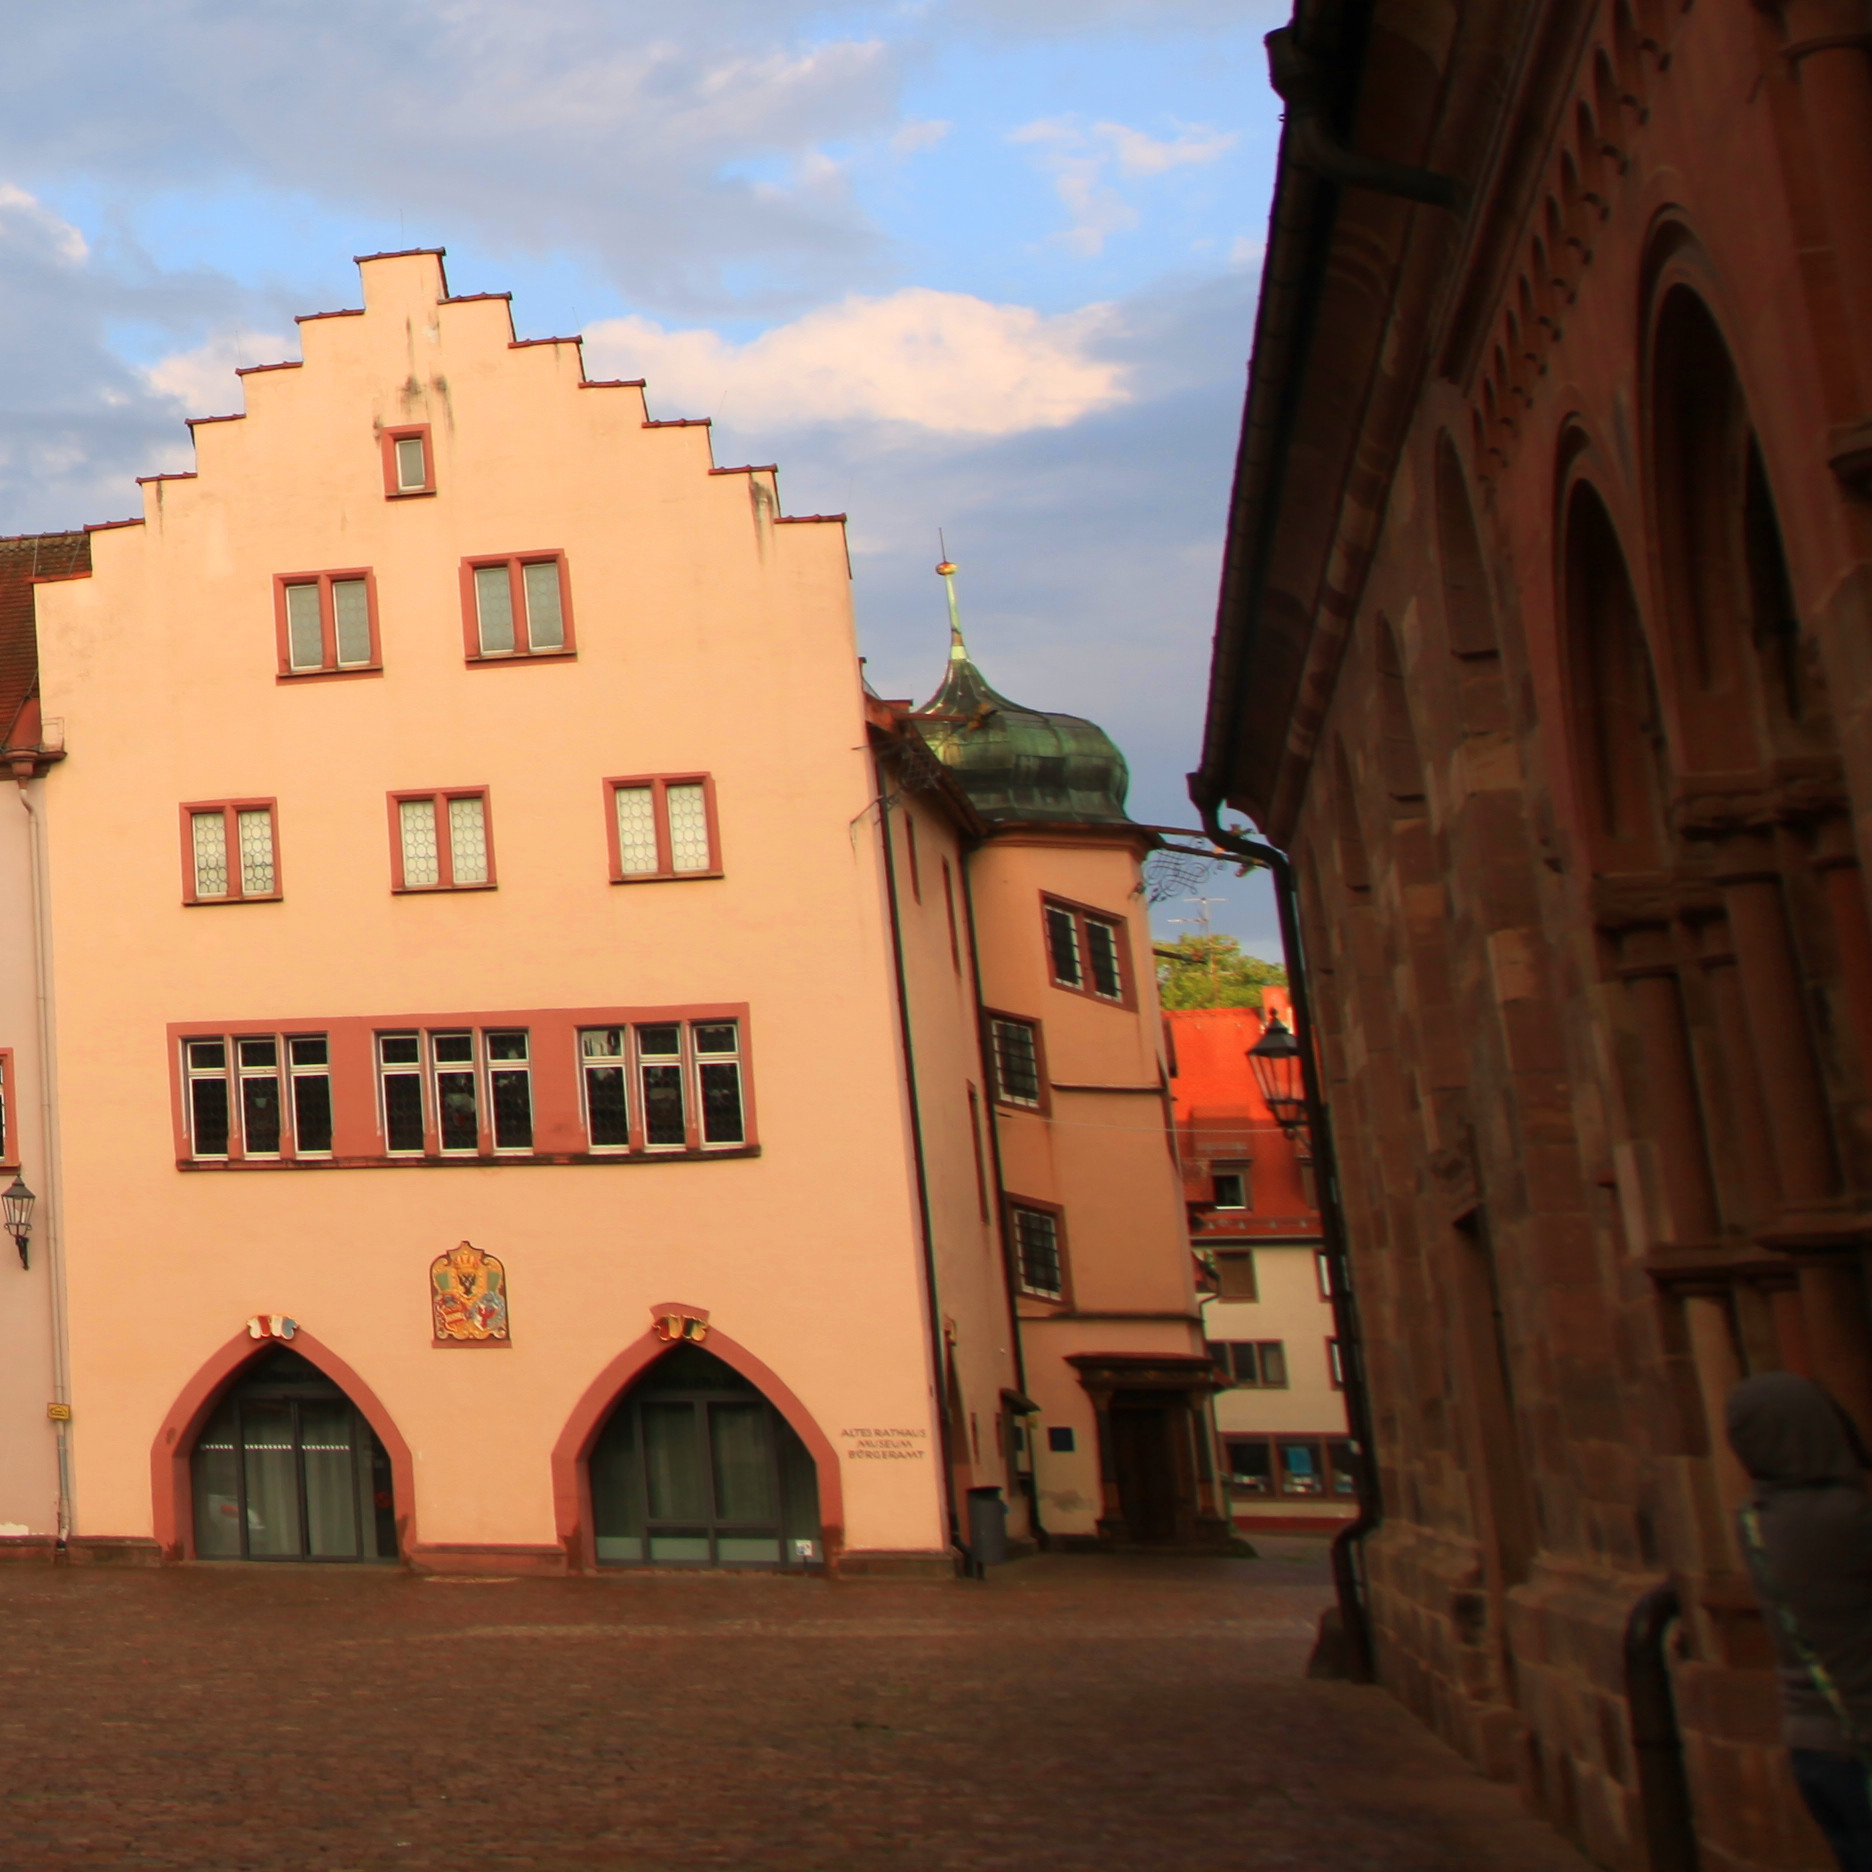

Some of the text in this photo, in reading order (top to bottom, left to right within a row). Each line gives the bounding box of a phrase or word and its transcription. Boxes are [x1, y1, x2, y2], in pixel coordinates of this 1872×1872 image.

[841, 1428, 927, 1438] ALTES RATHAUS
[857, 1439, 913, 1449] MUSEUM
